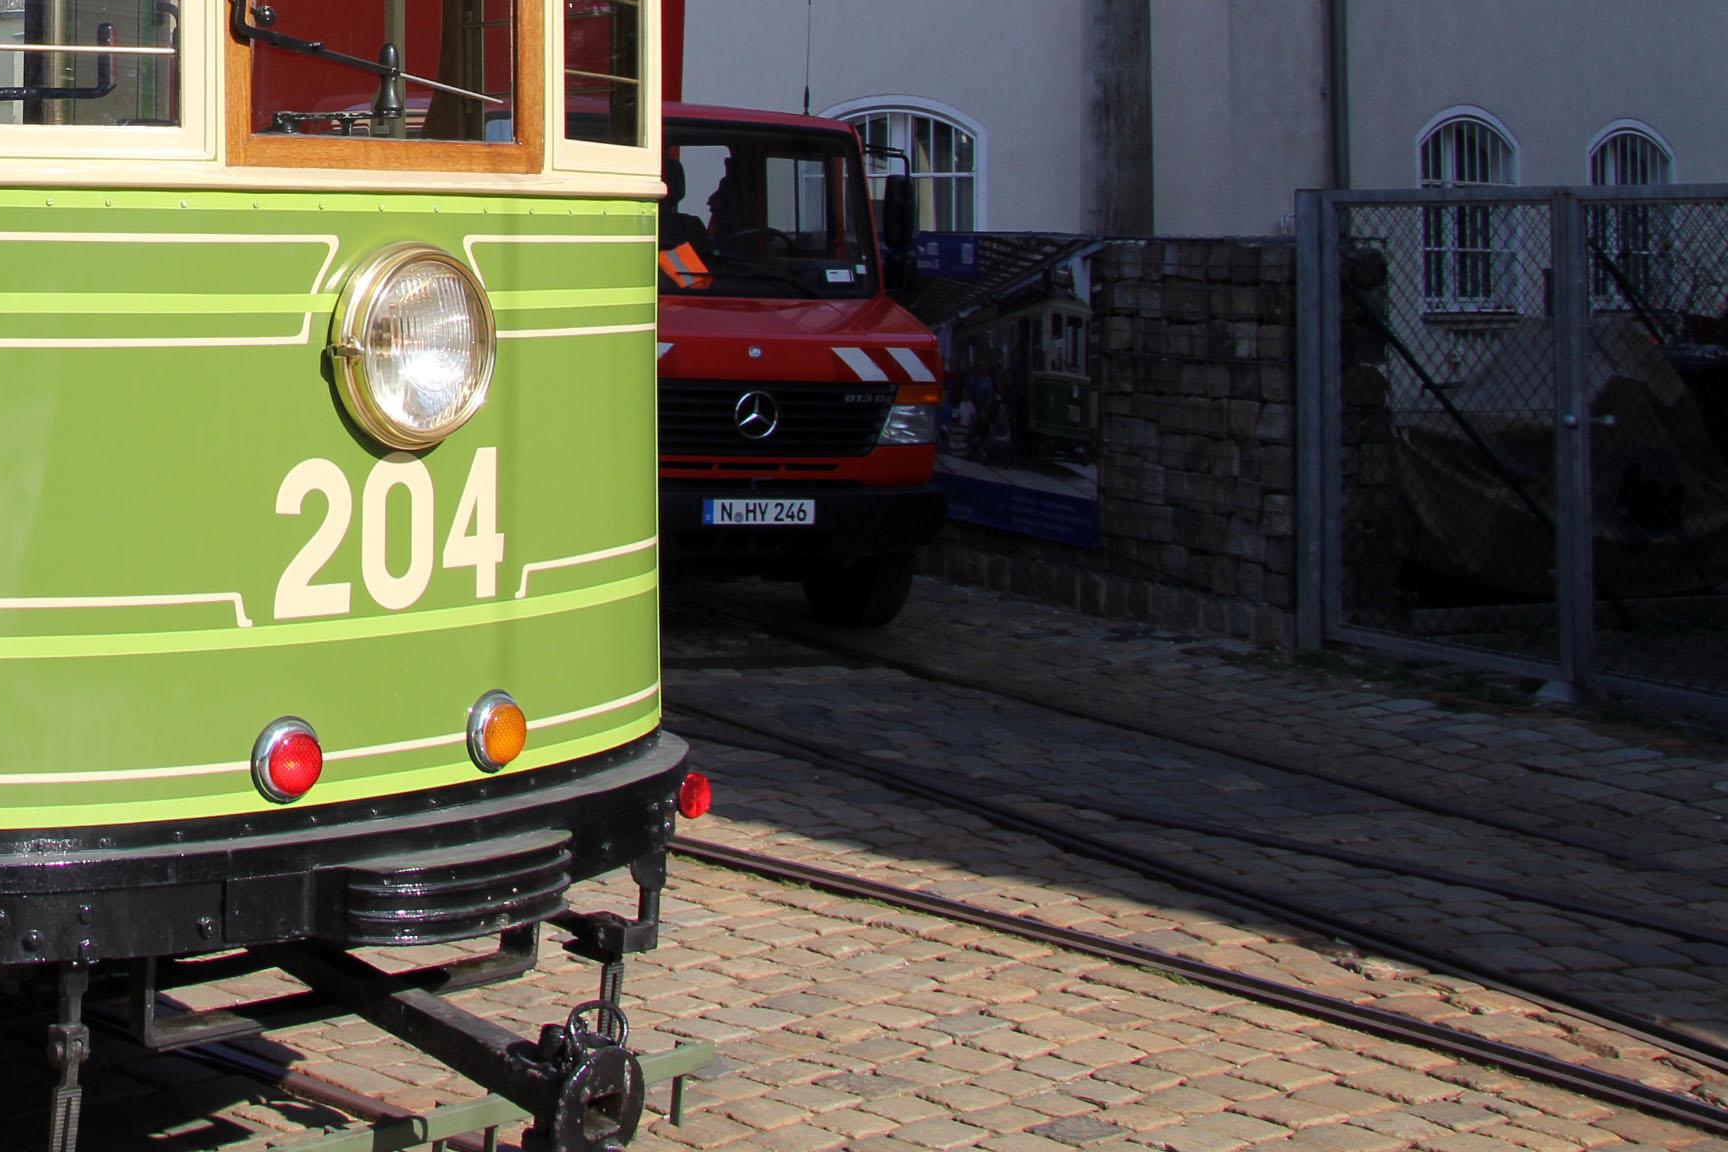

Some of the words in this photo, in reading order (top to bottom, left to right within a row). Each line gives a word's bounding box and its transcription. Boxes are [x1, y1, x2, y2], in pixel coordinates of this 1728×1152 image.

[273, 446, 505, 620] 204
[720, 502, 733, 522] N
[745, 502, 769, 522] HY
[774, 502, 807, 522] 246
